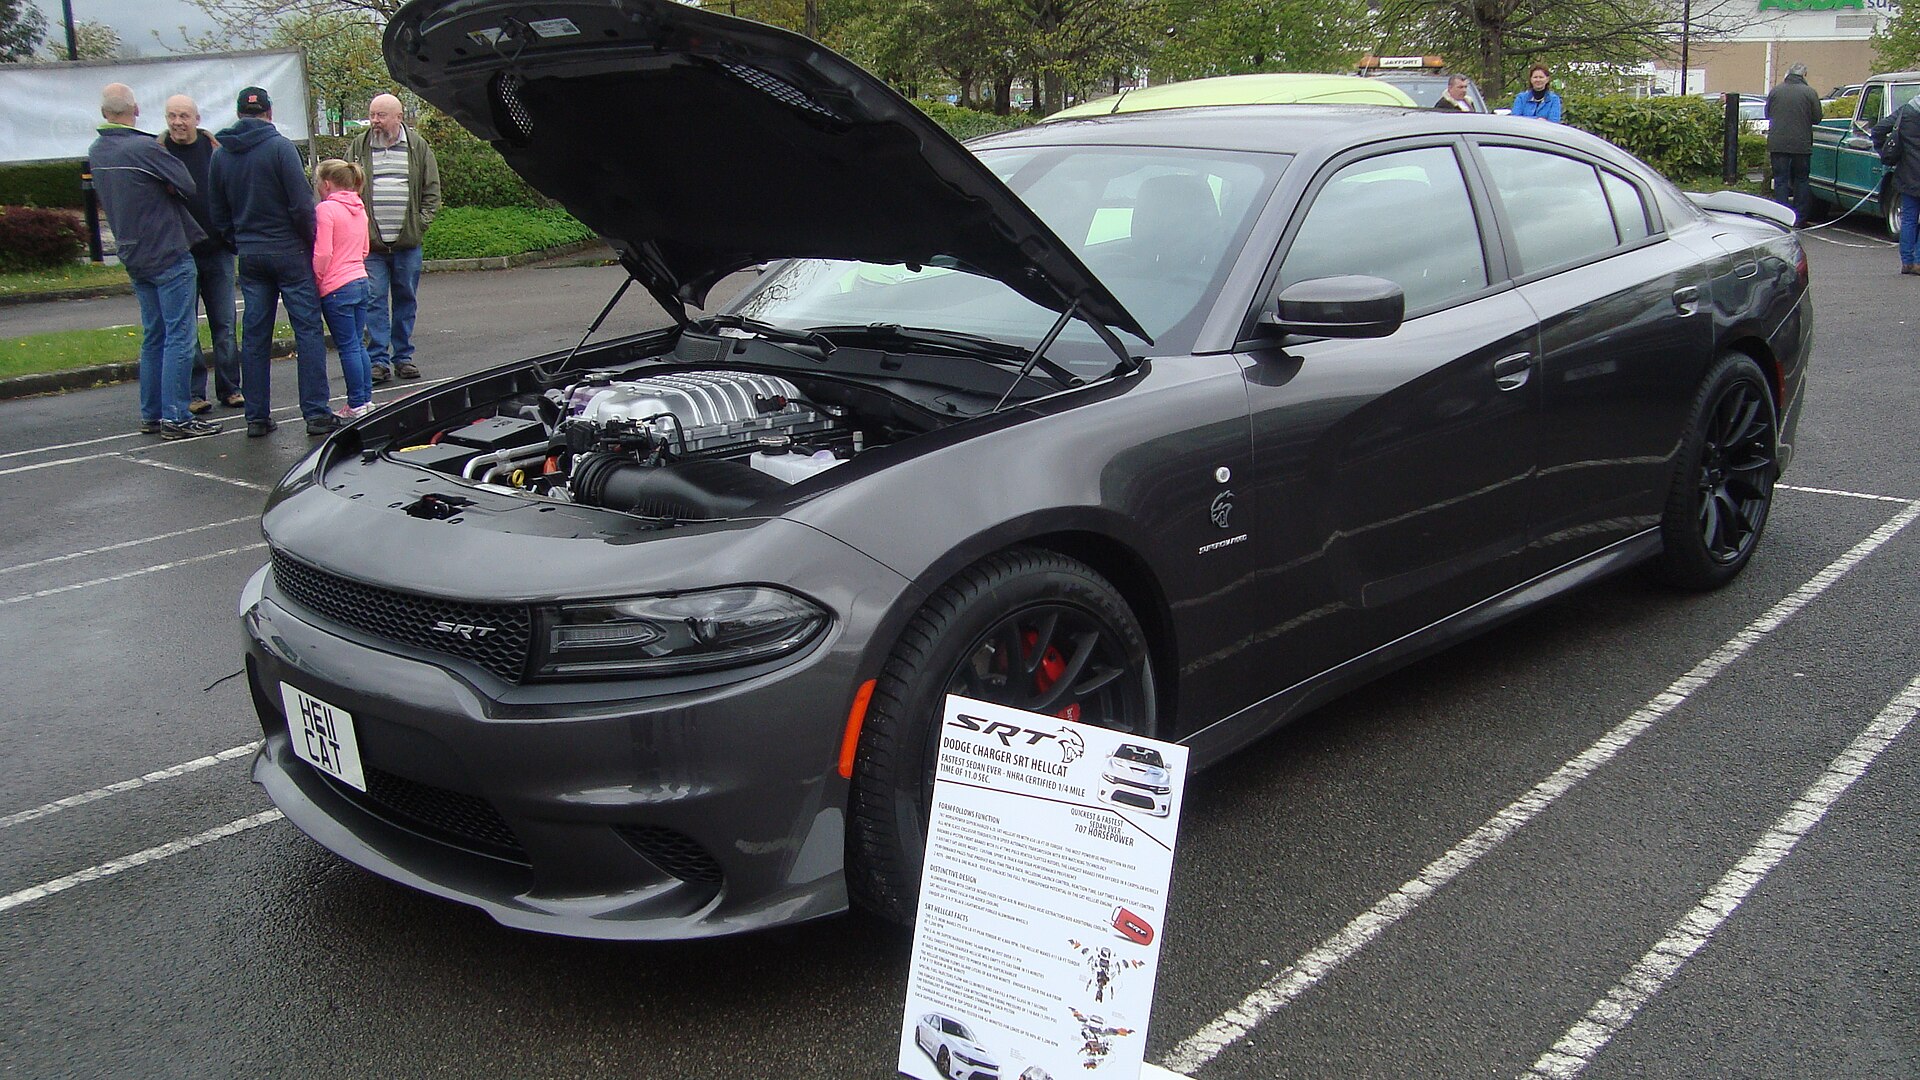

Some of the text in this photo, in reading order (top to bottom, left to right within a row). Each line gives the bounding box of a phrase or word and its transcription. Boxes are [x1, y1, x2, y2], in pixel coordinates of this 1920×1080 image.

[432, 621, 497, 639] SRT
[946, 713, 1057, 747] SRT
[305, 728, 341, 774] CAT
[943, 737, 1068, 777] DODGE CHARGER SRT HELLCAT
[940, 763, 990, 783] TIME OF 11.0 SEC.
[941, 753, 965, 766] FASTEST
[966, 759, 985, 771] SEDAN
[986, 764, 1001, 775] EVER
[1006, 770, 1023, 781] NHRA
[1025, 774, 1056, 790] CERTIFIED
[1058, 783, 1068, 792] 1/4
[1069, 786, 1085, 797] MILE
[938, 801, 999, 824] FORM FOLLOWS FUNCTION
[1070, 807, 1096, 820] QUICKEST
[1101, 815, 1123, 827] FASTEST
[1074, 823, 1134, 846] 707 HORSEPOWER
[1089, 820, 1107, 830] SEDAN
[1107, 824, 1121, 835] EVER
[929, 864, 958, 878] DISTINCTIVE
[958, 872, 976, 884] DESIGN
[924, 902, 968, 922] SRT HELLCAT FACTS
